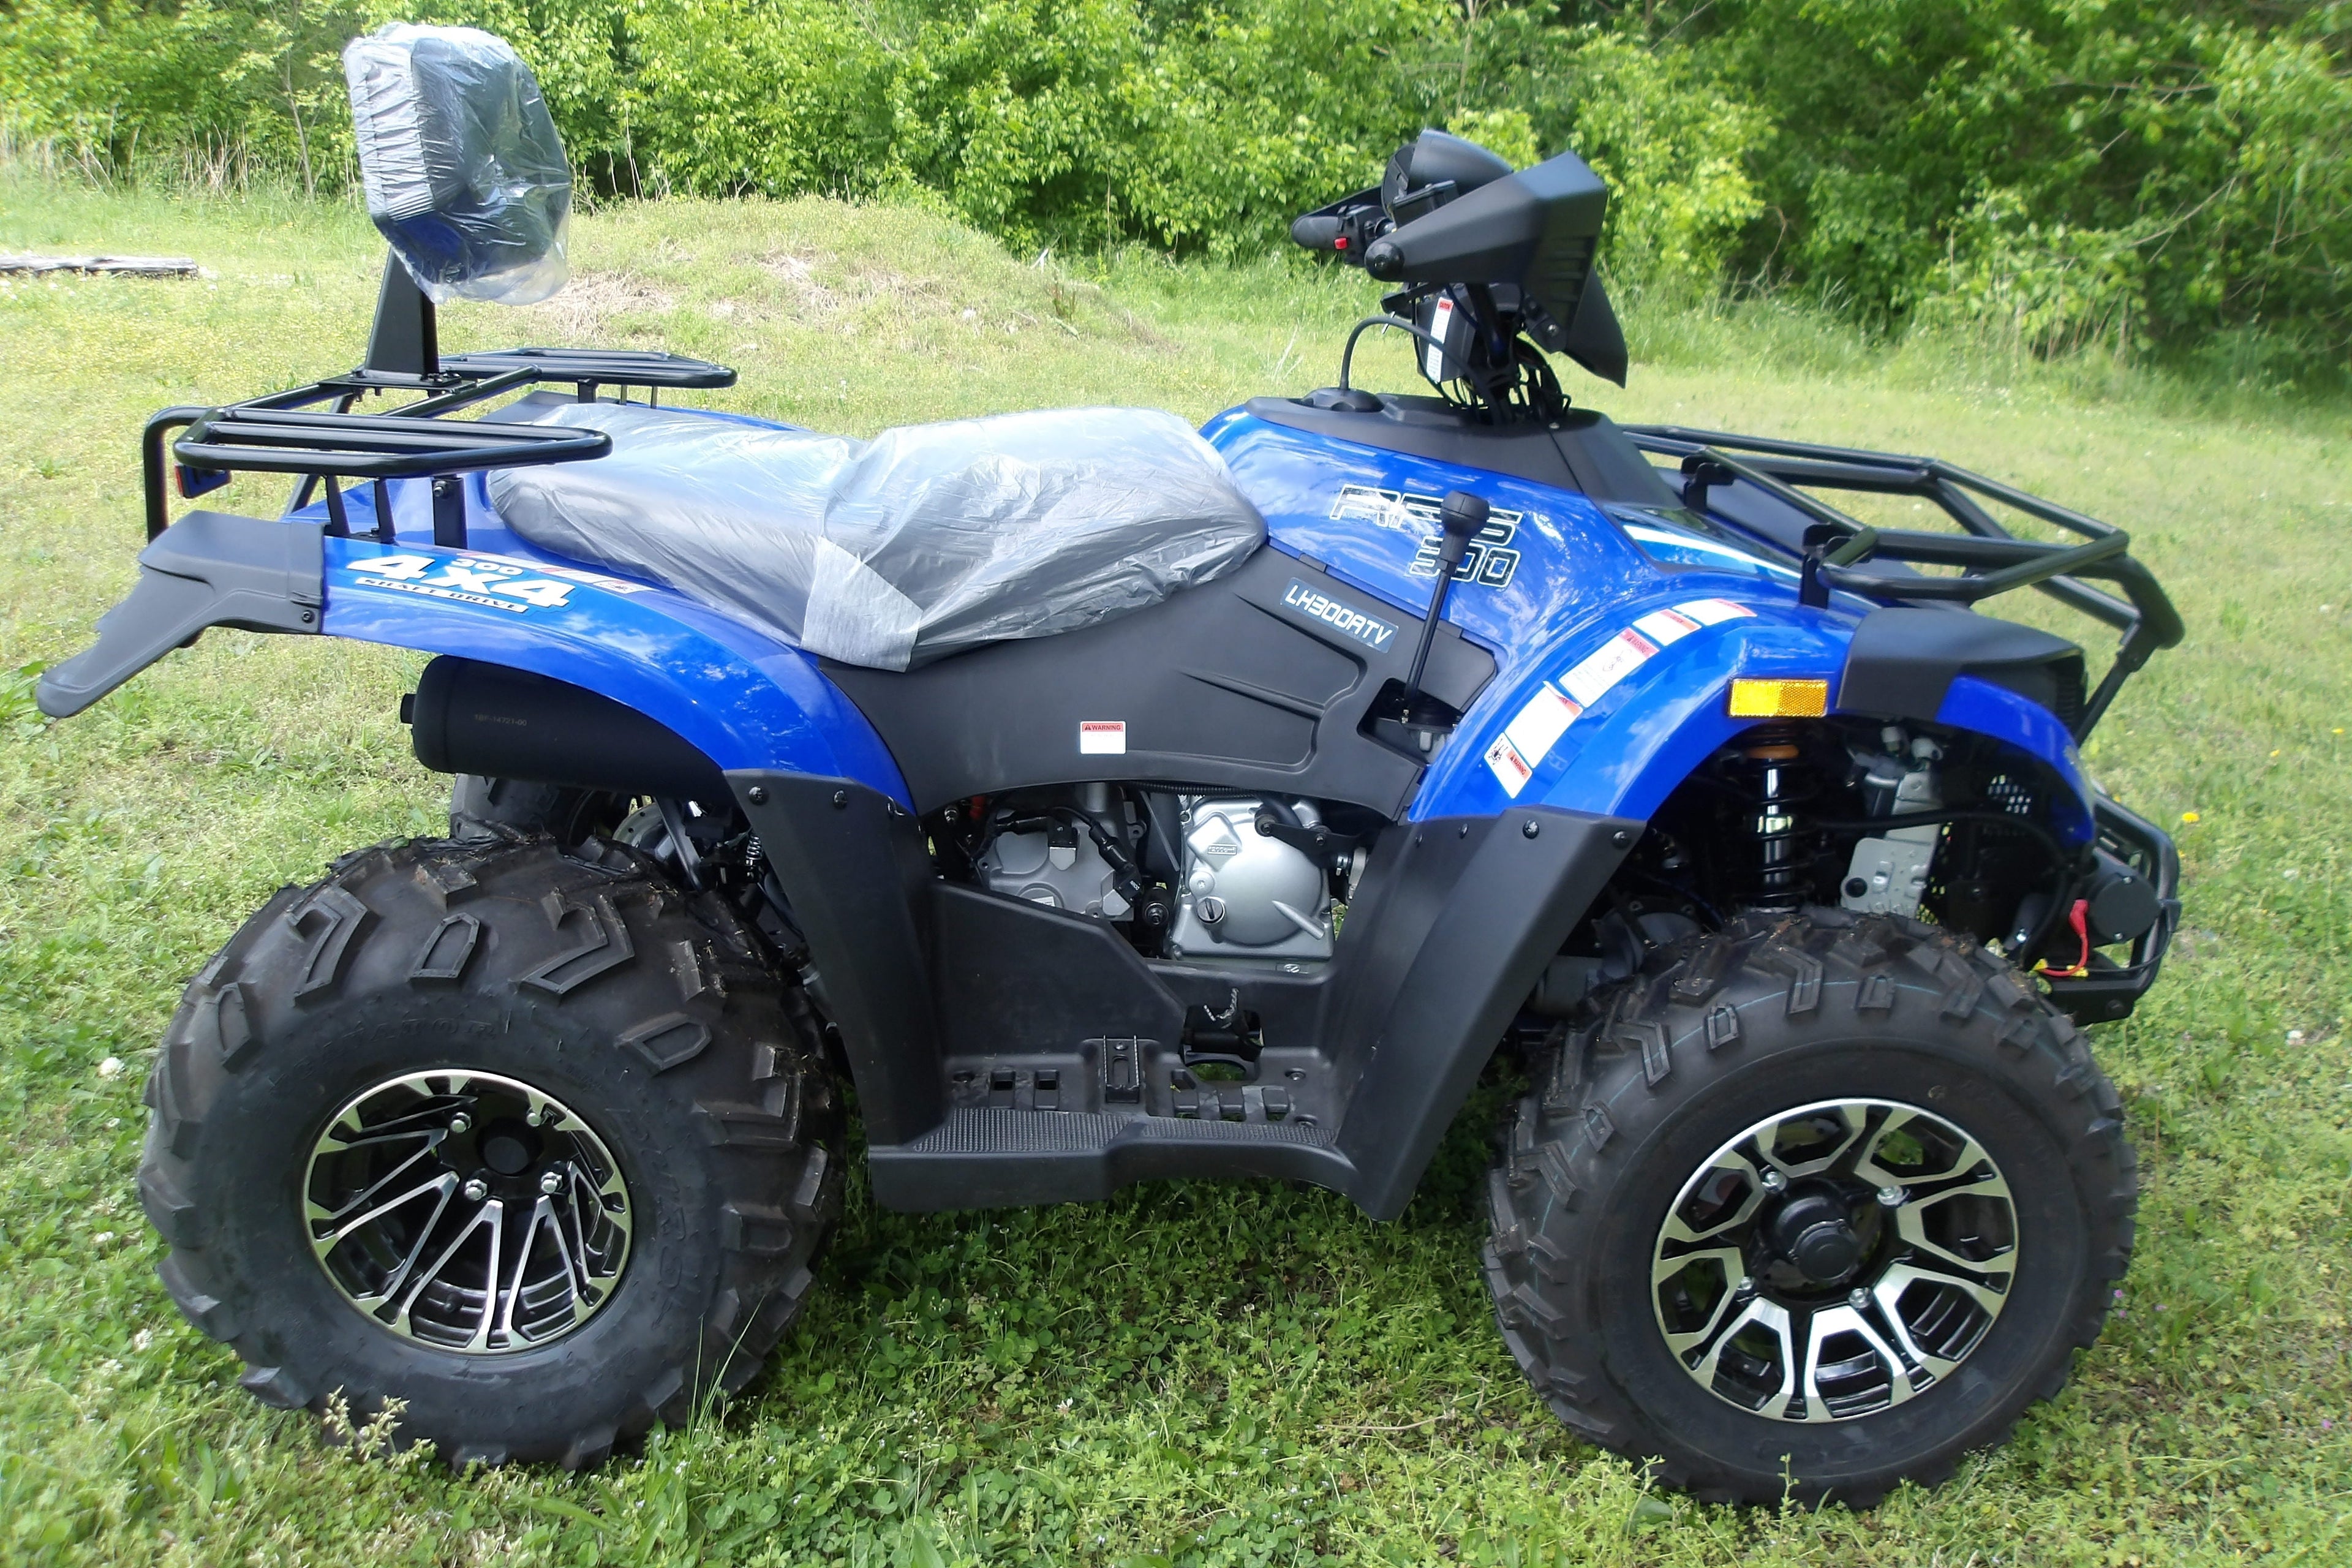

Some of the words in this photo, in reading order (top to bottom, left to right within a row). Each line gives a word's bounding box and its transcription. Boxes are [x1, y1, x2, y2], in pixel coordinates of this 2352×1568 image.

[451, 559, 524, 576] 300
[450, 592, 521, 610] DRIVE
[1285, 585, 1393, 644] LH300ATV
